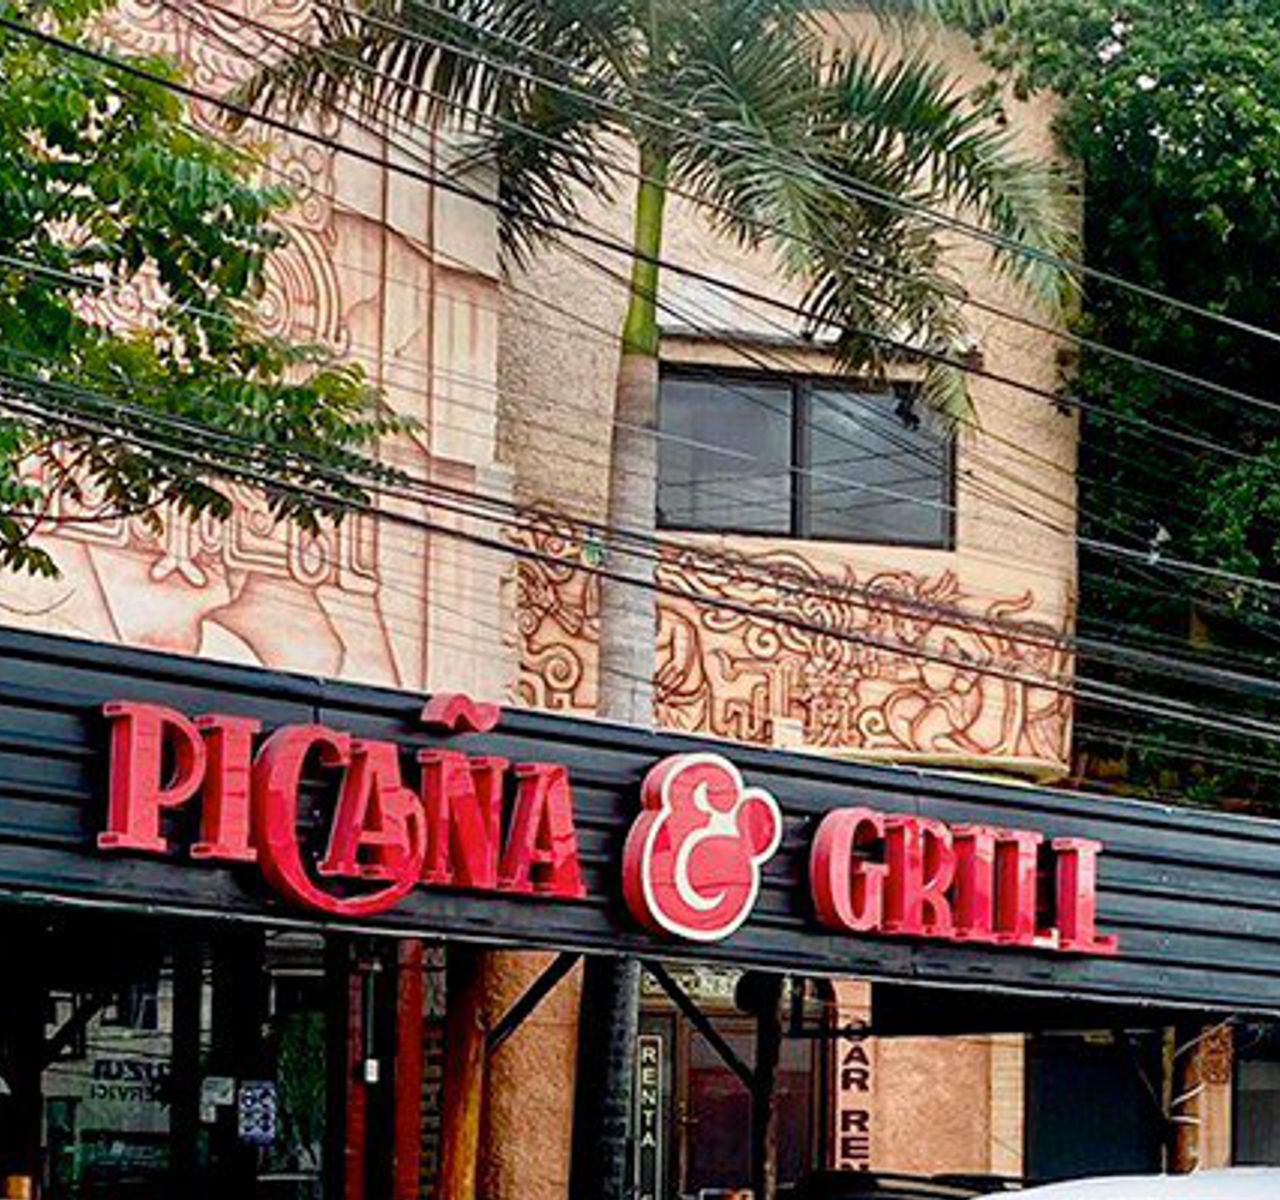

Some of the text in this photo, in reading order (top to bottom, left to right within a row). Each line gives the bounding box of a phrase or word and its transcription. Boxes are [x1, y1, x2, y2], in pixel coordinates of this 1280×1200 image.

[98, 692, 1118, 955] PICAÑA & GRILL
[640, 1047, 656, 1147] RENTA
[842, 1020, 869, 1091] CAR
